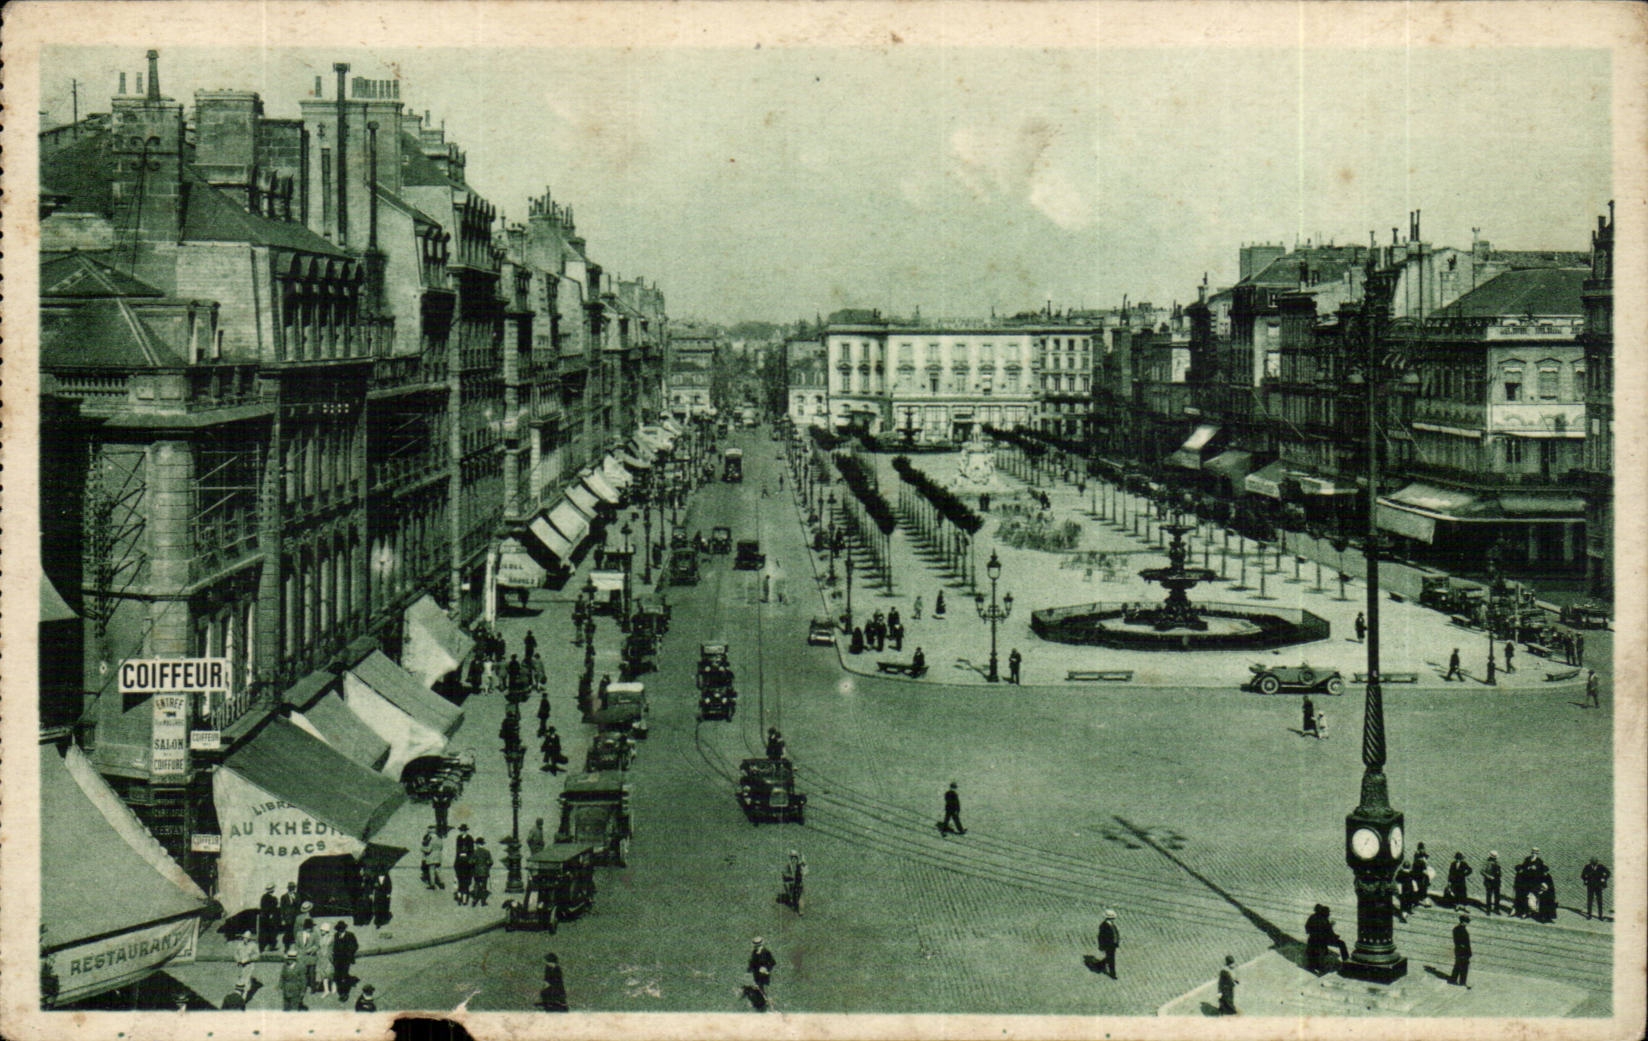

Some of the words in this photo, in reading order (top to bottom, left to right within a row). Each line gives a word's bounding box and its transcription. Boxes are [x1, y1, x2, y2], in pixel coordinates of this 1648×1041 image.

[123, 662, 222, 689] COIFFEUR
[154, 738, 184, 750] SALON
[229, 821, 254, 838] AU
[256, 840, 326, 857] TABACS
[70, 931, 182, 977] RESTAURANT
